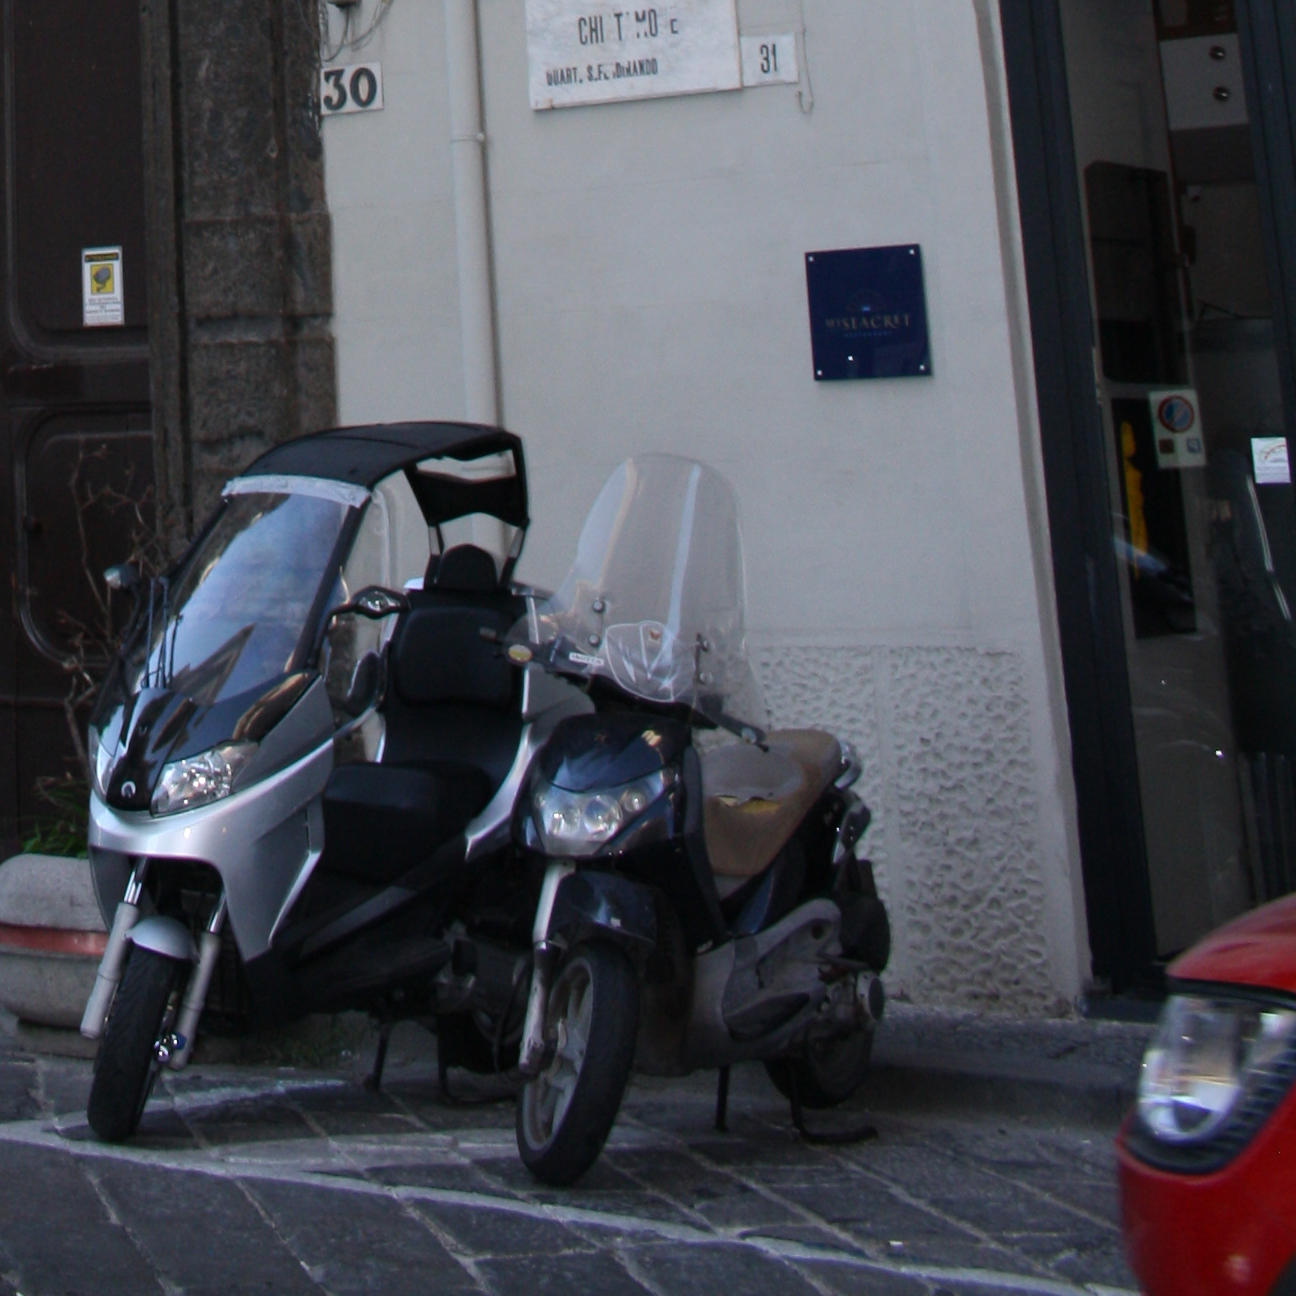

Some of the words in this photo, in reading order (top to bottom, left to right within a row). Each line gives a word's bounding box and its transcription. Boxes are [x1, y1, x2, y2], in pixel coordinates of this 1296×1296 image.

[577, 8, 680, 46] CHITMOE
[759, 42, 779, 75] 31
[323, 66, 378, 111] 30
